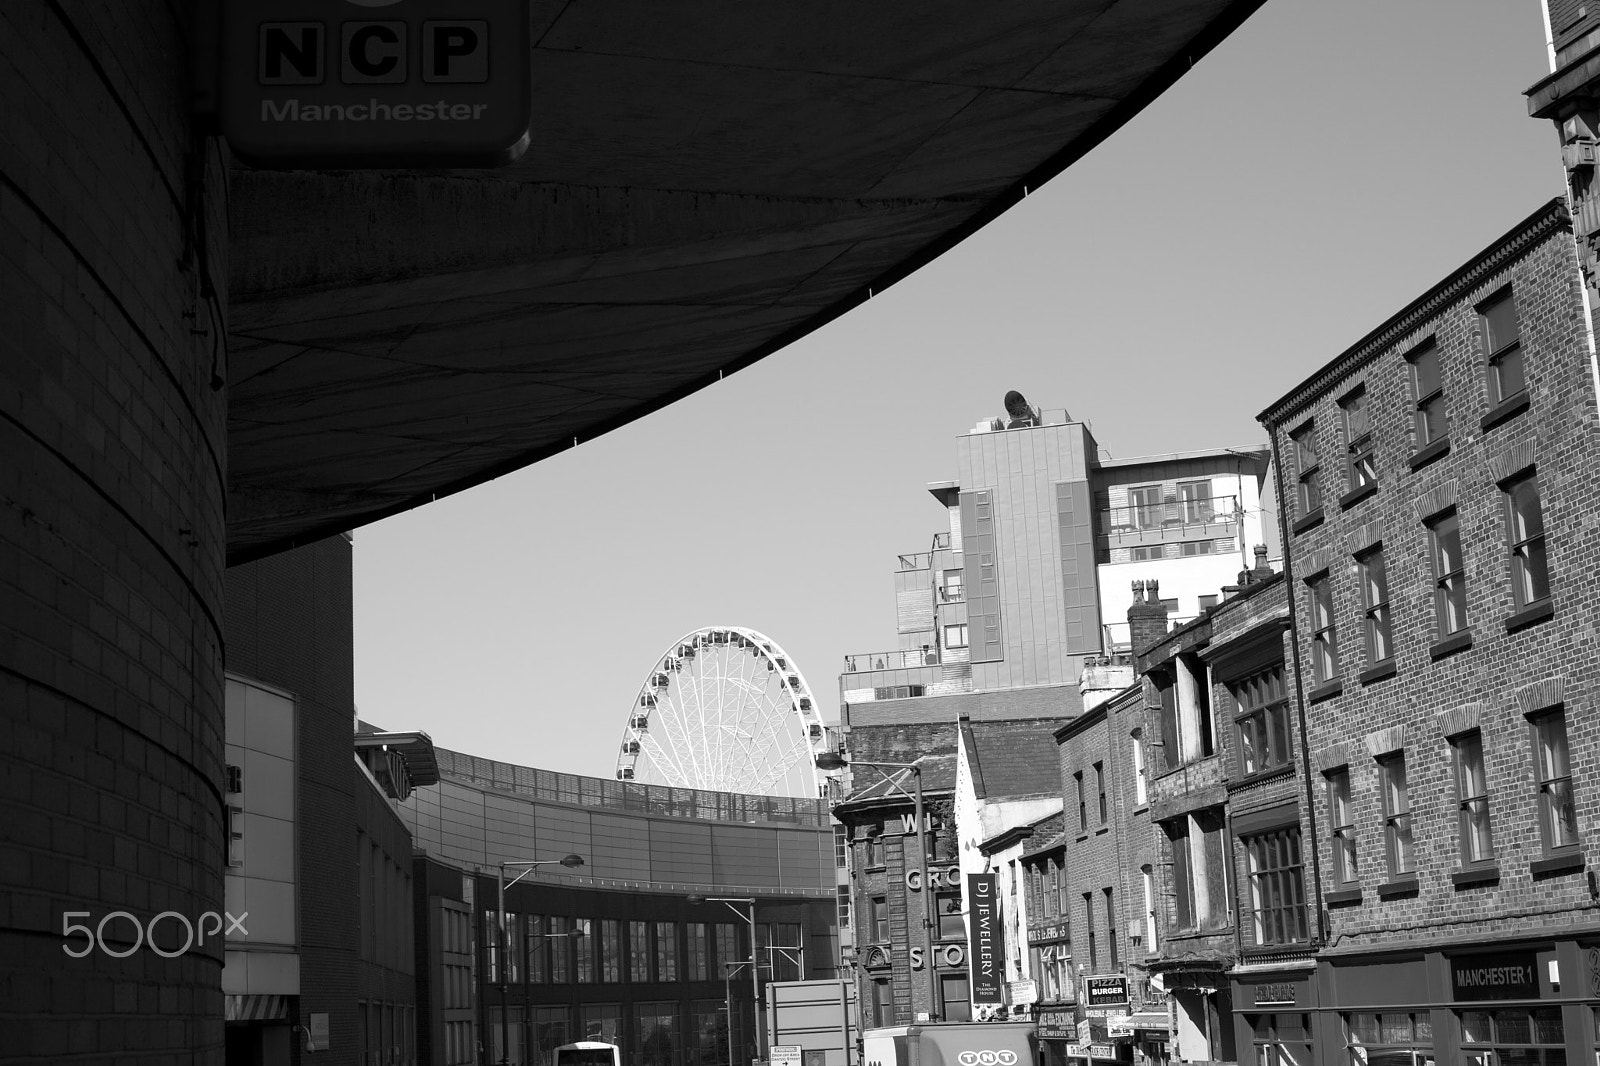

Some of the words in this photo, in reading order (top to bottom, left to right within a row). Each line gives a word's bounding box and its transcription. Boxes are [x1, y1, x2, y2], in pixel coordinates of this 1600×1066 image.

[265, 25, 478, 78] NCP
[261, 98, 487, 122] Manchester
[975, 882, 989, 899] DJ
[975, 903, 993, 978] JEWELLERY
[1091, 978, 1122, 987] PIZZA
[1457, 966, 1525, 987] MANCHESTER
[1527, 965, 1533, 983] 1
[1091, 987, 1124, 996] BURGER
[1092, 995, 1125, 1004] KEBAB
[961, 1051, 1014, 1064] TNT
